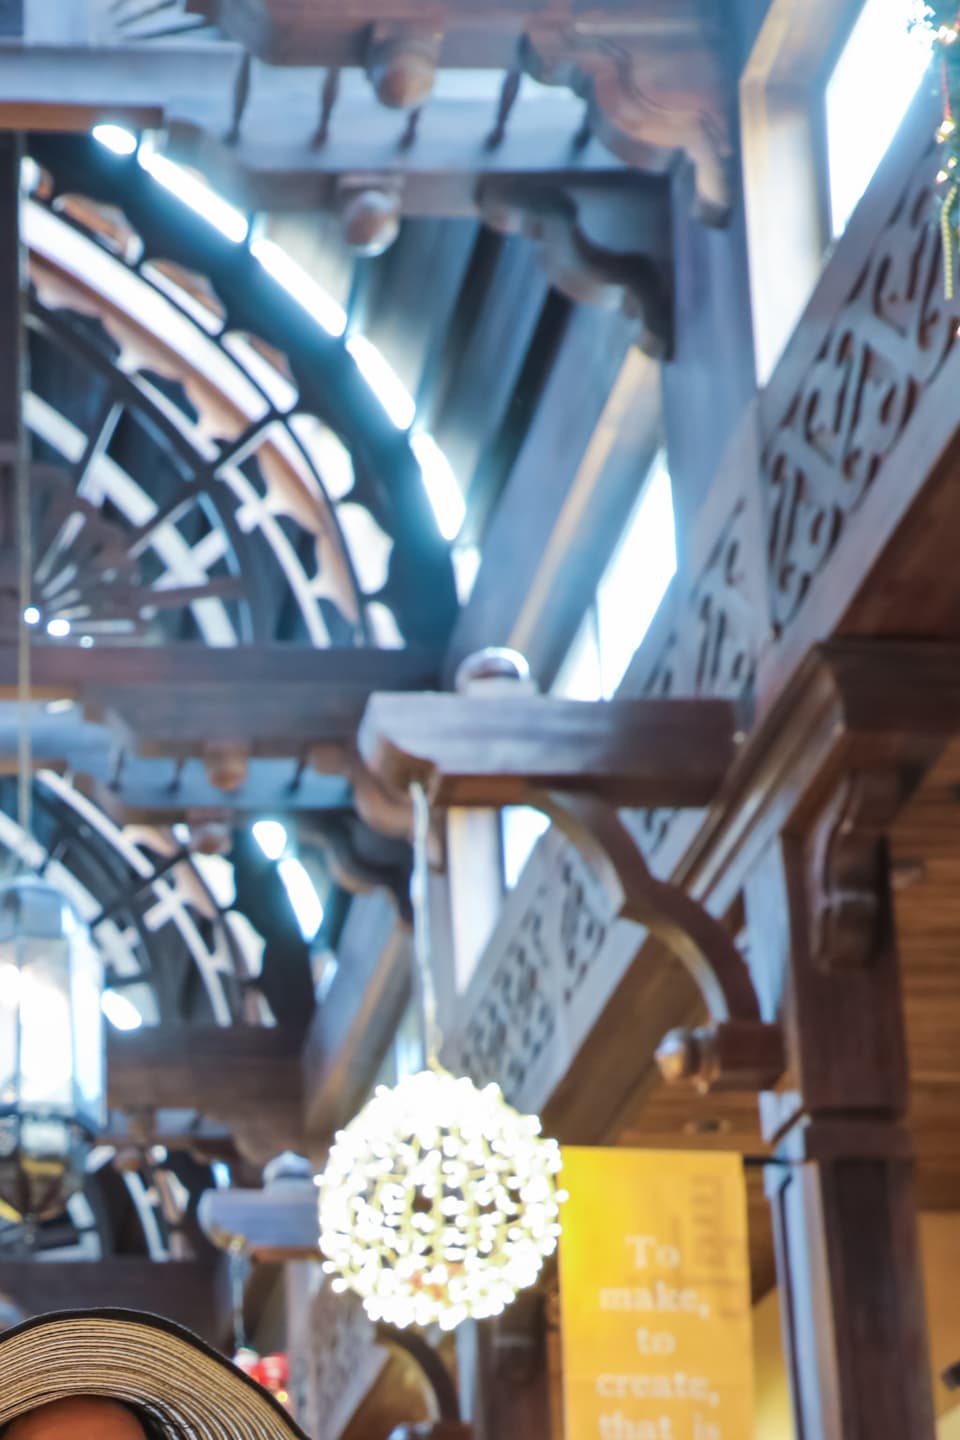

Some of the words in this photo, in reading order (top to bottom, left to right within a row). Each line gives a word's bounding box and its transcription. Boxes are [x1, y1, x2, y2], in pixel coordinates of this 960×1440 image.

[624, 1233, 681, 1270] To
[597, 1280, 711, 1320] make,
[635, 1326, 678, 1357] to
[594, 1370, 720, 1408] create,
